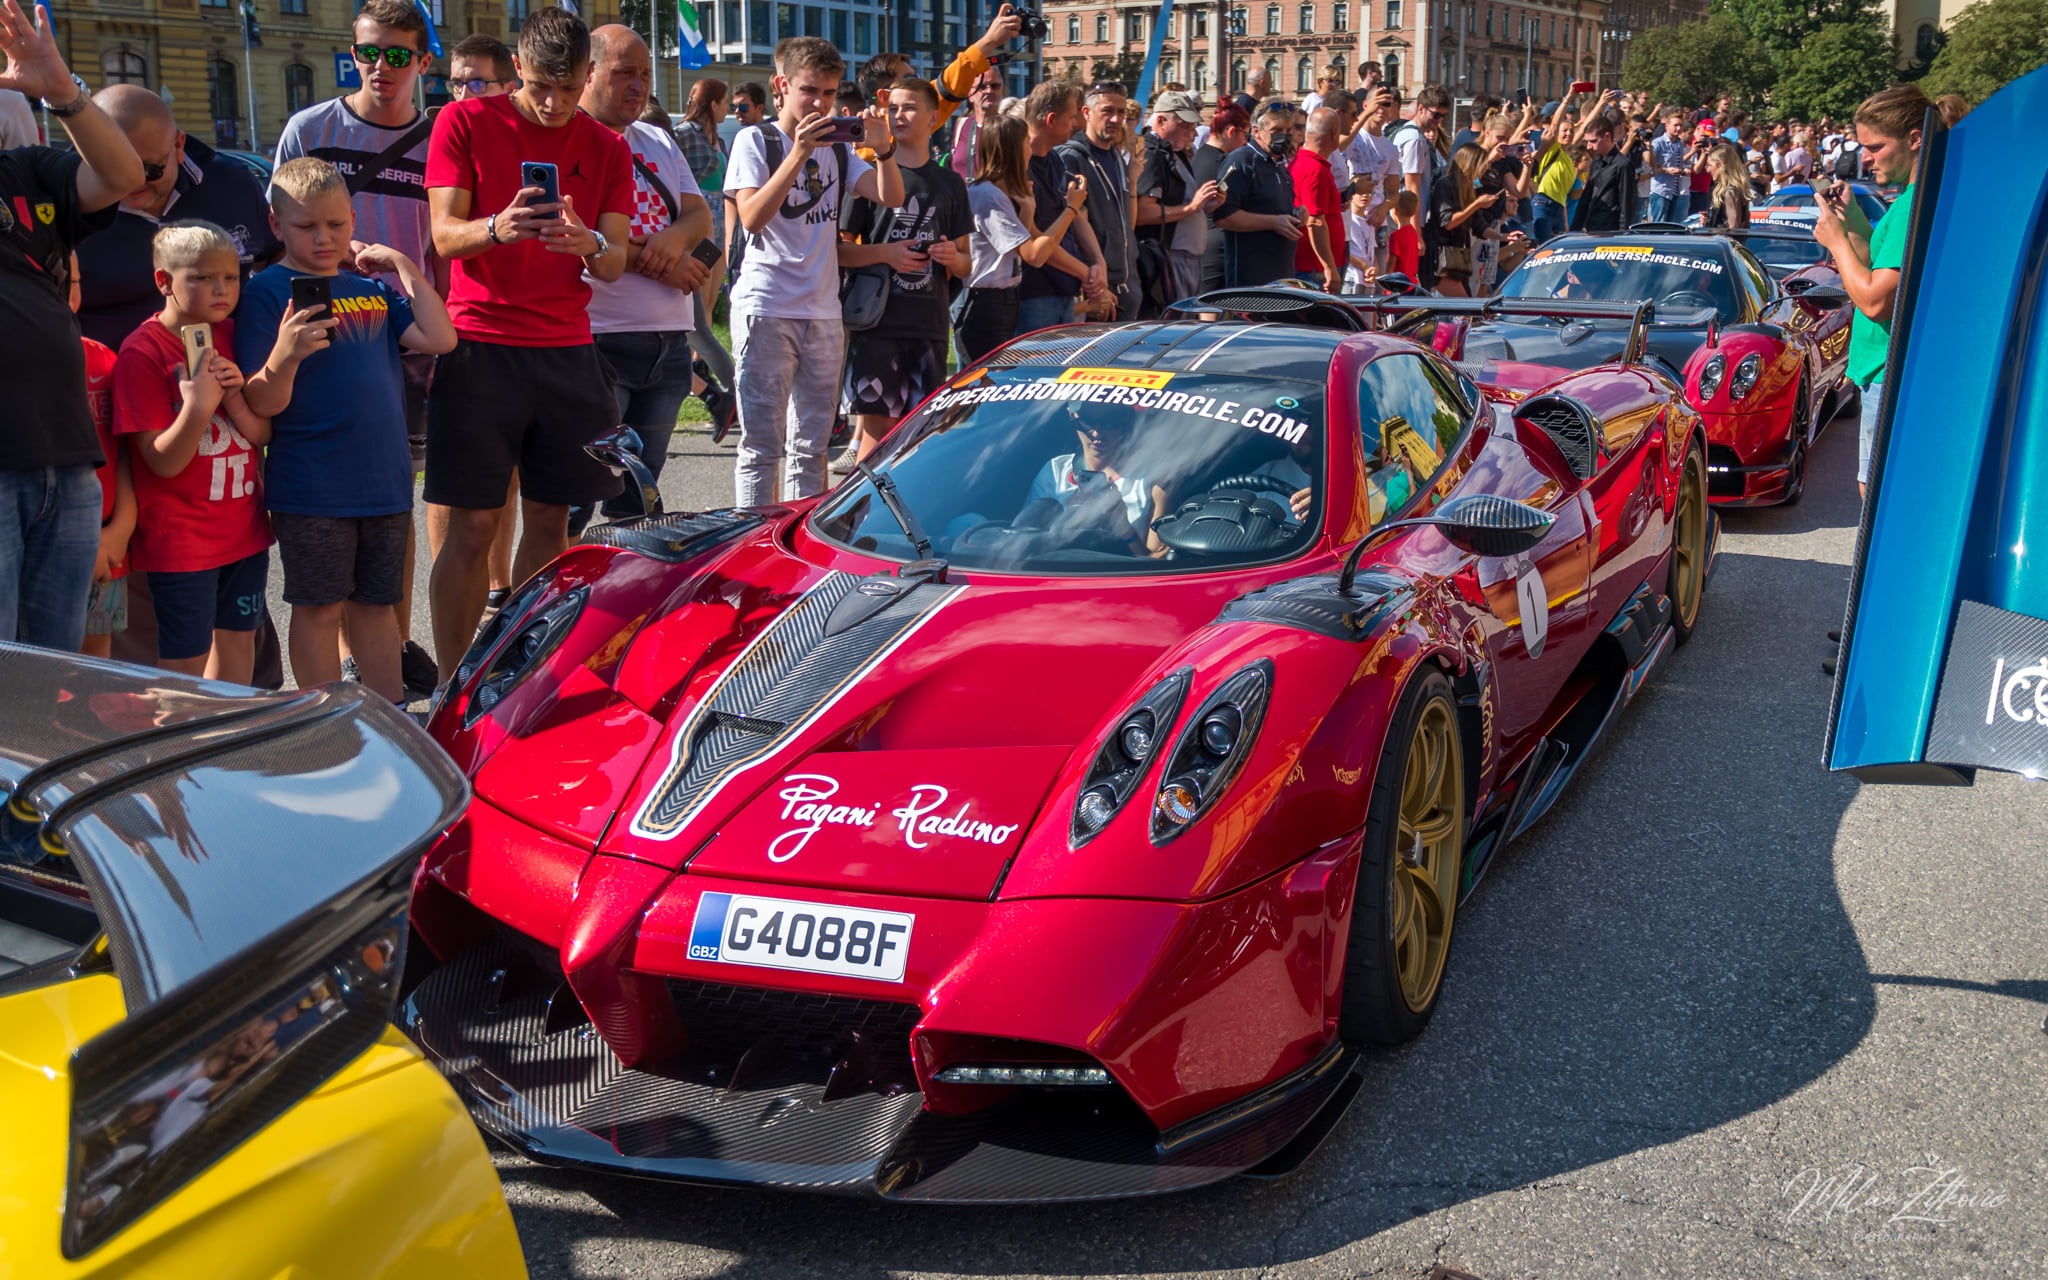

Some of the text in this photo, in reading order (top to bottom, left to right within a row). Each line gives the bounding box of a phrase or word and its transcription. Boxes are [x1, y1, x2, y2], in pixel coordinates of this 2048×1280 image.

[340, 59, 356, 82] P
[328, 161, 357, 176] ARL
[1523, 251, 1723, 275] SUPERCAROWNERSCIRCLE.COM
[1069, 370, 1161, 386] PIRELLI
[923, 382, 1309, 445] SUPERCAROWNERSCIRCLE.COM
[209, 453, 254, 500] IT.
[768, 773, 1019, 863] Pagani Raduno
[727, 907, 907, 967] G4088F
[690, 944, 718, 960] GBZ
